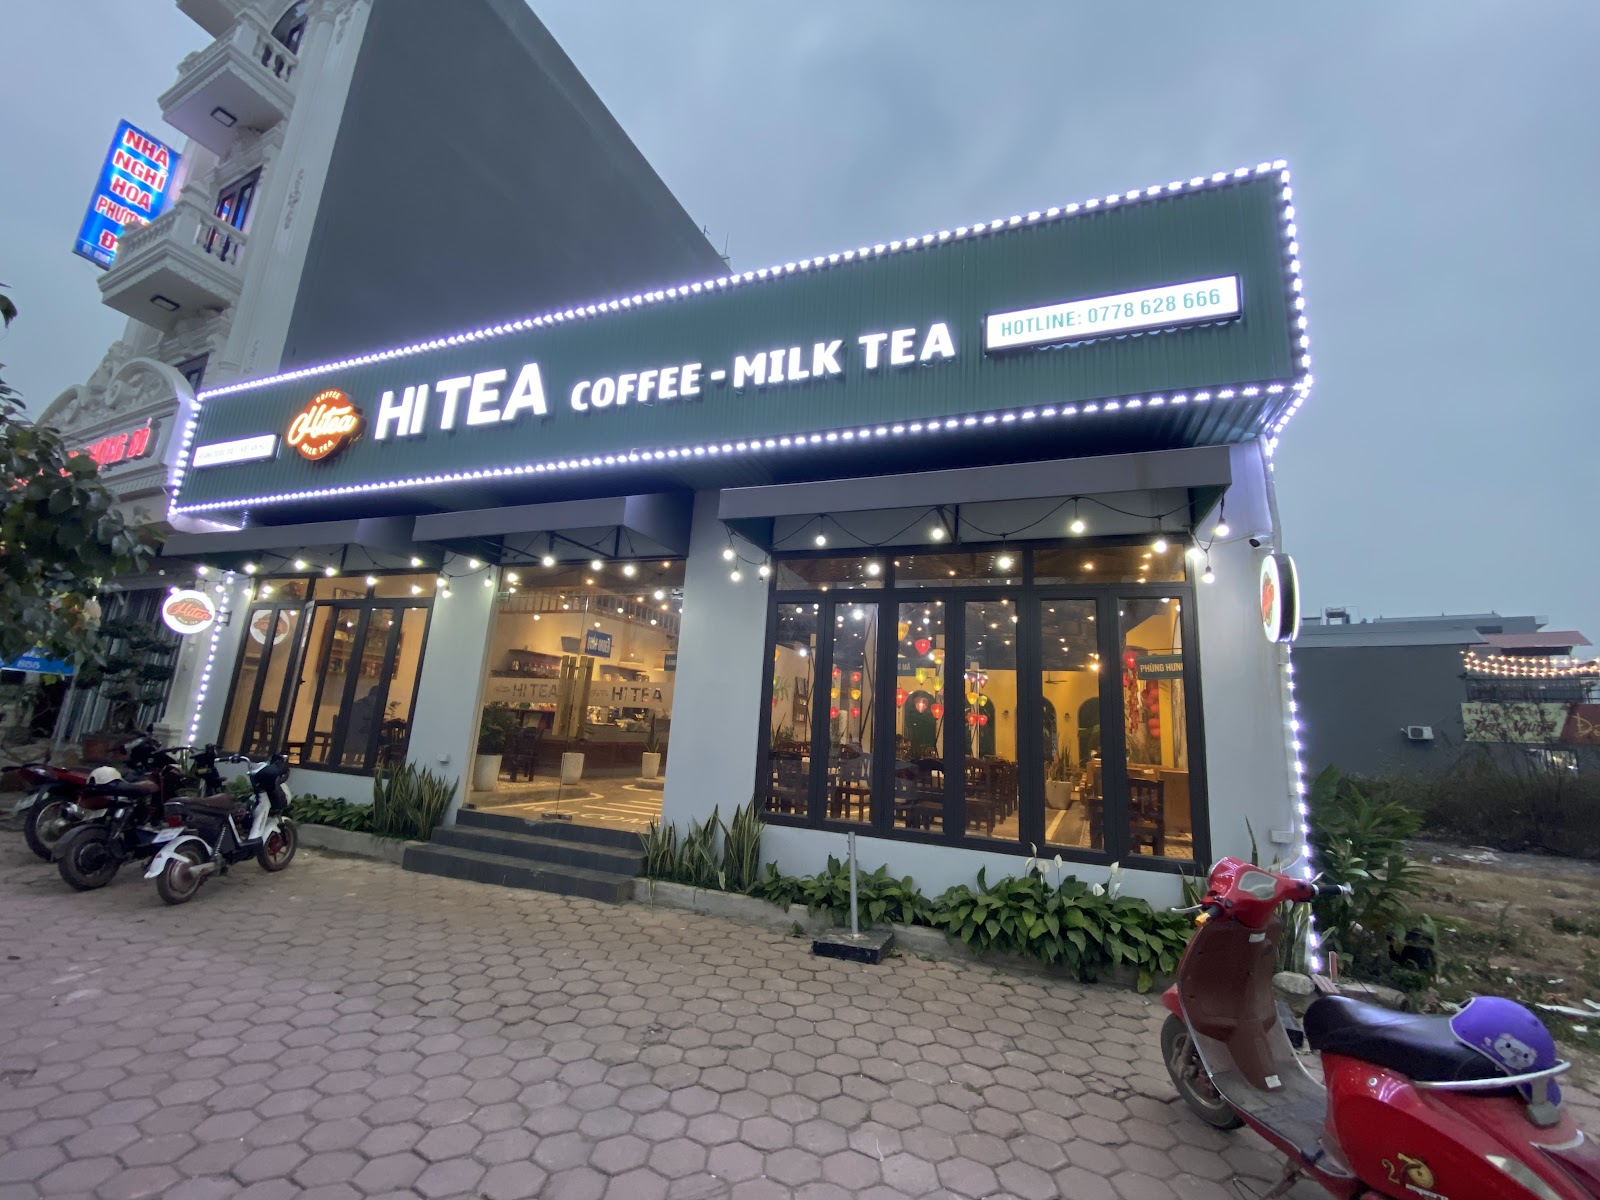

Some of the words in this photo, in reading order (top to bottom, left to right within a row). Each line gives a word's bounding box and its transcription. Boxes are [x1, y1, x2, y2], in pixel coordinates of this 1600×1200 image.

[109, 173, 152, 213] HOA
[1001, 310, 1082, 337] HOTLINE:
[1087, 302, 1134, 324] 0778
[1140, 295, 1176, 316] 628
[1183, 288, 1221, 309] 666
[374, 383, 429, 440] HI
[435, 362, 548, 430] TEA
[570, 362, 702, 411] COFFEE
[733, 339, 843, 388] MILK
[858, 322, 956, 369] TEA
